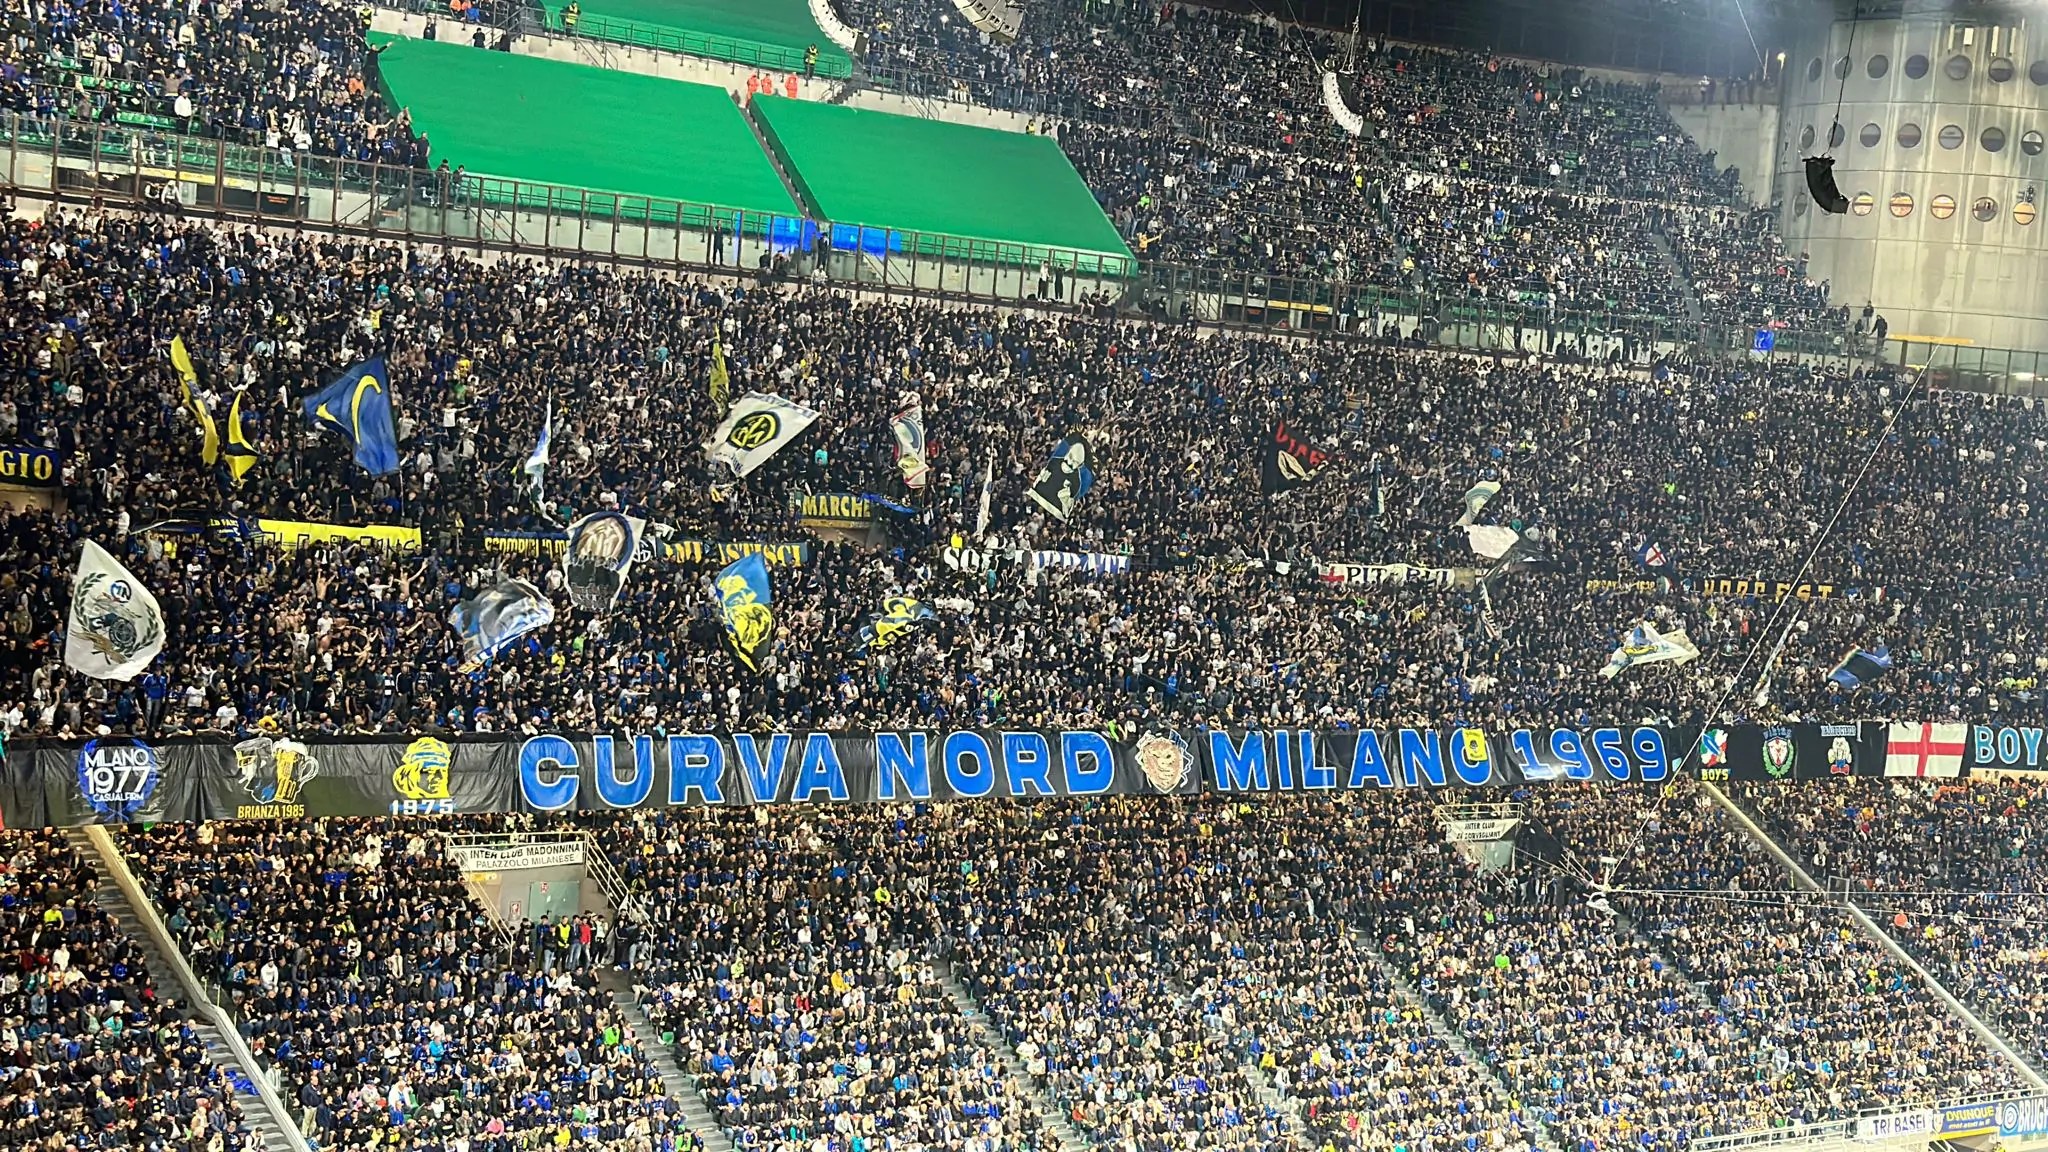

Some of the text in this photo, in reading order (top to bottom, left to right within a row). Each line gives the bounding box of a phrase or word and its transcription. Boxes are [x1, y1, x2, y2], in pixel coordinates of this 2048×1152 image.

[0, 450, 53, 480] GIO
[803, 495, 871, 518] MARCHE
[1346, 566, 1388, 586] PIT
[1973, 724, 2048, 766] BOY
[84, 748, 149, 768] MILANO
[518, 726, 1668, 811] CURVA NORD MILANO 1969
[1701, 768, 1729, 781] BOYS
[84, 765, 151, 794] 1977
[237, 804, 305, 819] BRIANZA 1985
[392, 799, 454, 816] 1975
[470, 843, 581, 860] INTER CLUB MADONNINA
[475, 854, 575, 869] PALAZZOLO MILANESE
